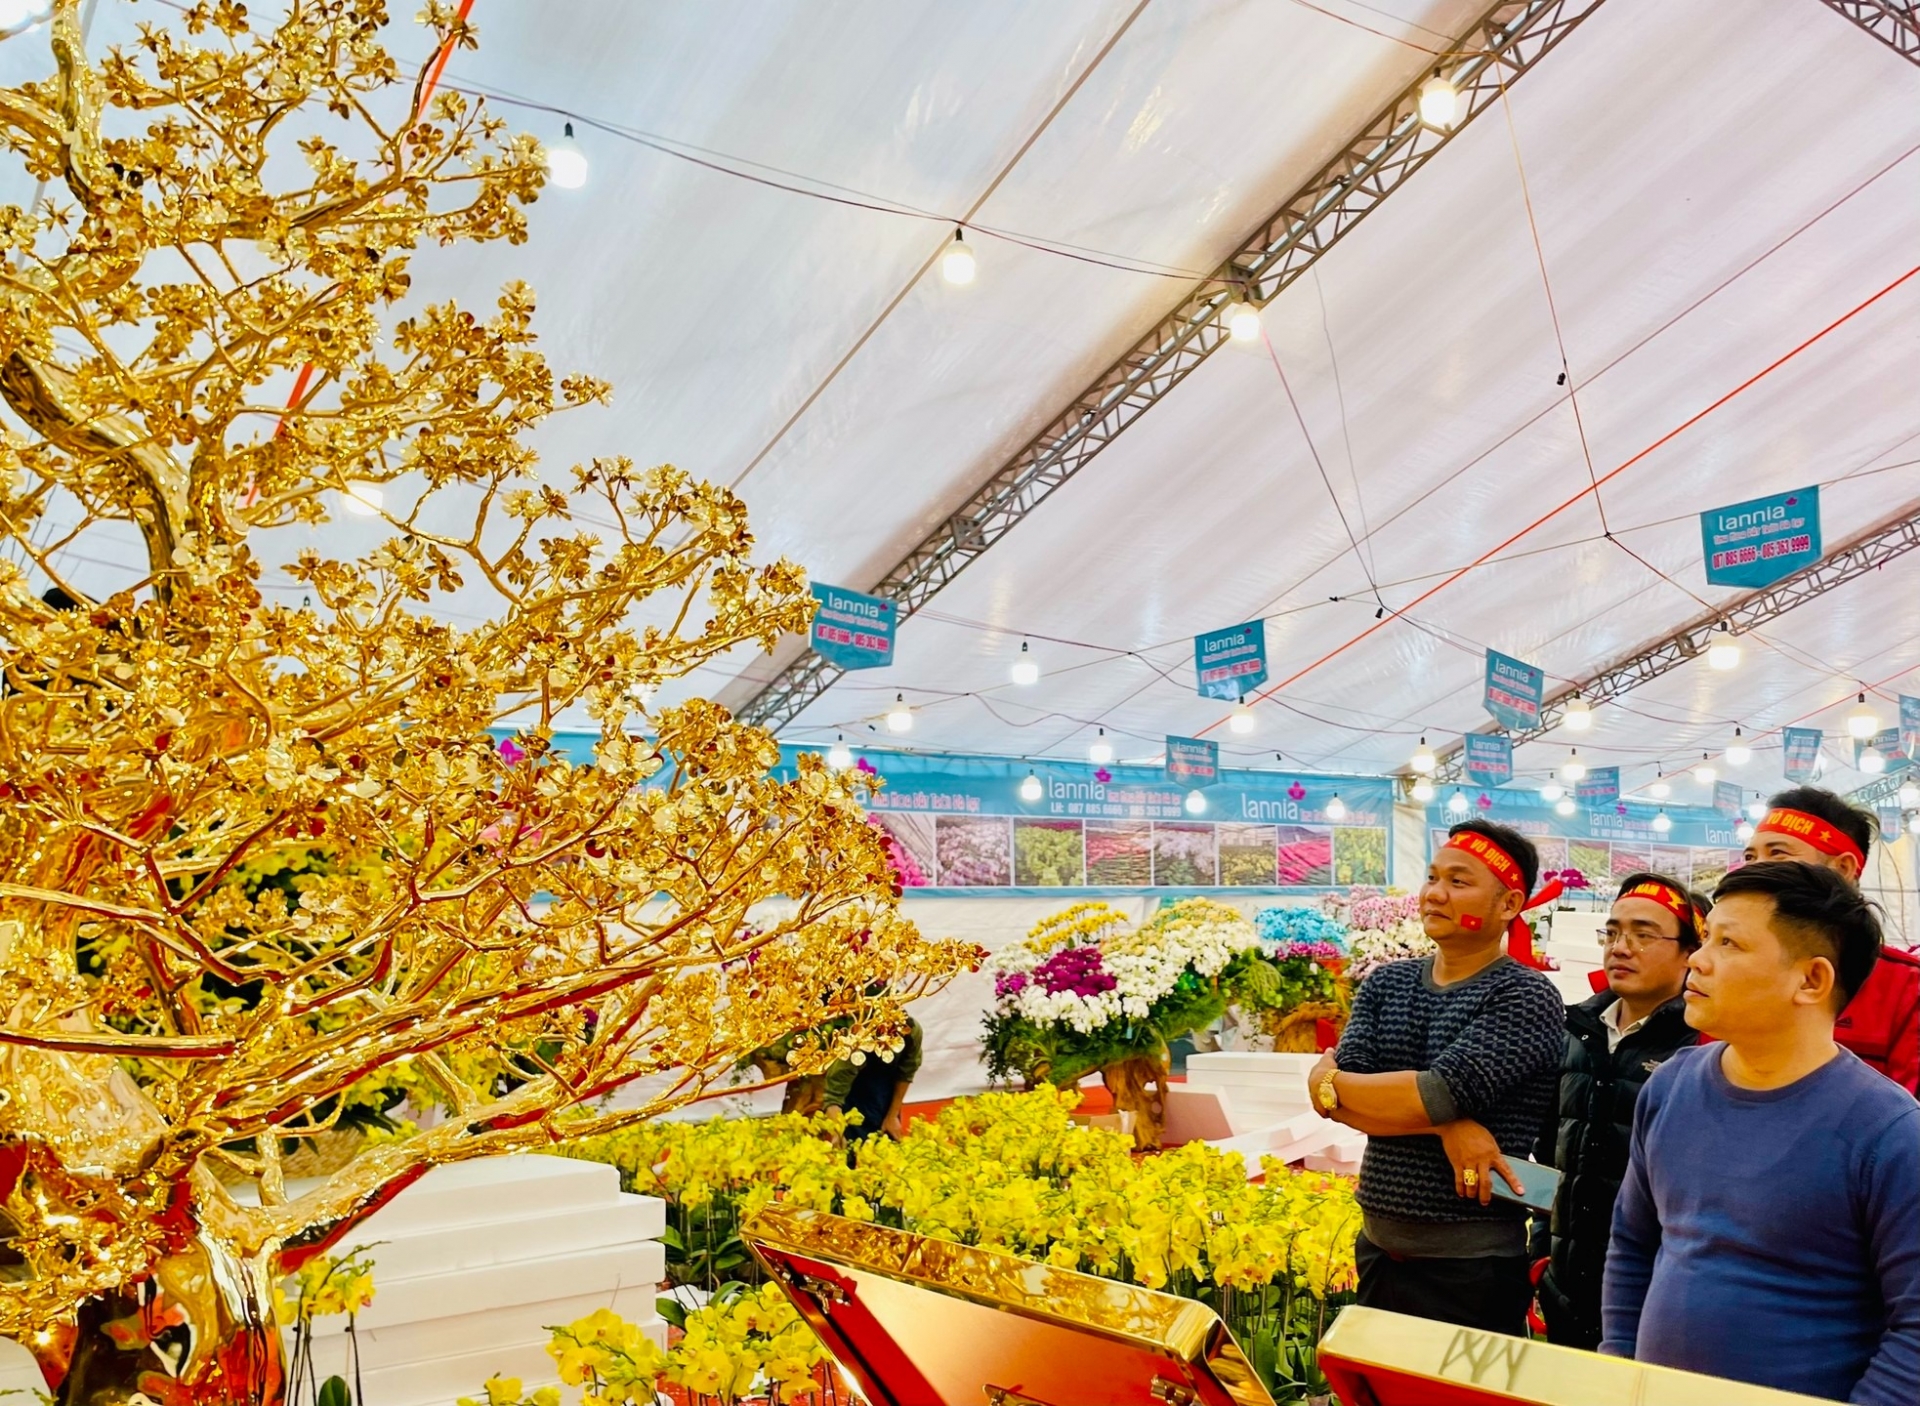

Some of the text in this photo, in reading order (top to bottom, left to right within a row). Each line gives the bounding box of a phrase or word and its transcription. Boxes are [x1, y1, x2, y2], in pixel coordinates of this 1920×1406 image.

[1719, 505, 1786, 532] lannia
[828, 591, 879, 618] lannia
[1204, 633, 1245, 653] lannia
[1495, 657, 1529, 684] lannia
[1048, 775, 1105, 800] lannia
[1240, 792, 1298, 821] lannia
[1588, 807, 1623, 828] lannia
[1780, 813, 1815, 835] ĐỊCH
[1483, 848, 1511, 873] ĐỊCH
[1634, 883, 1661, 897] NAM
